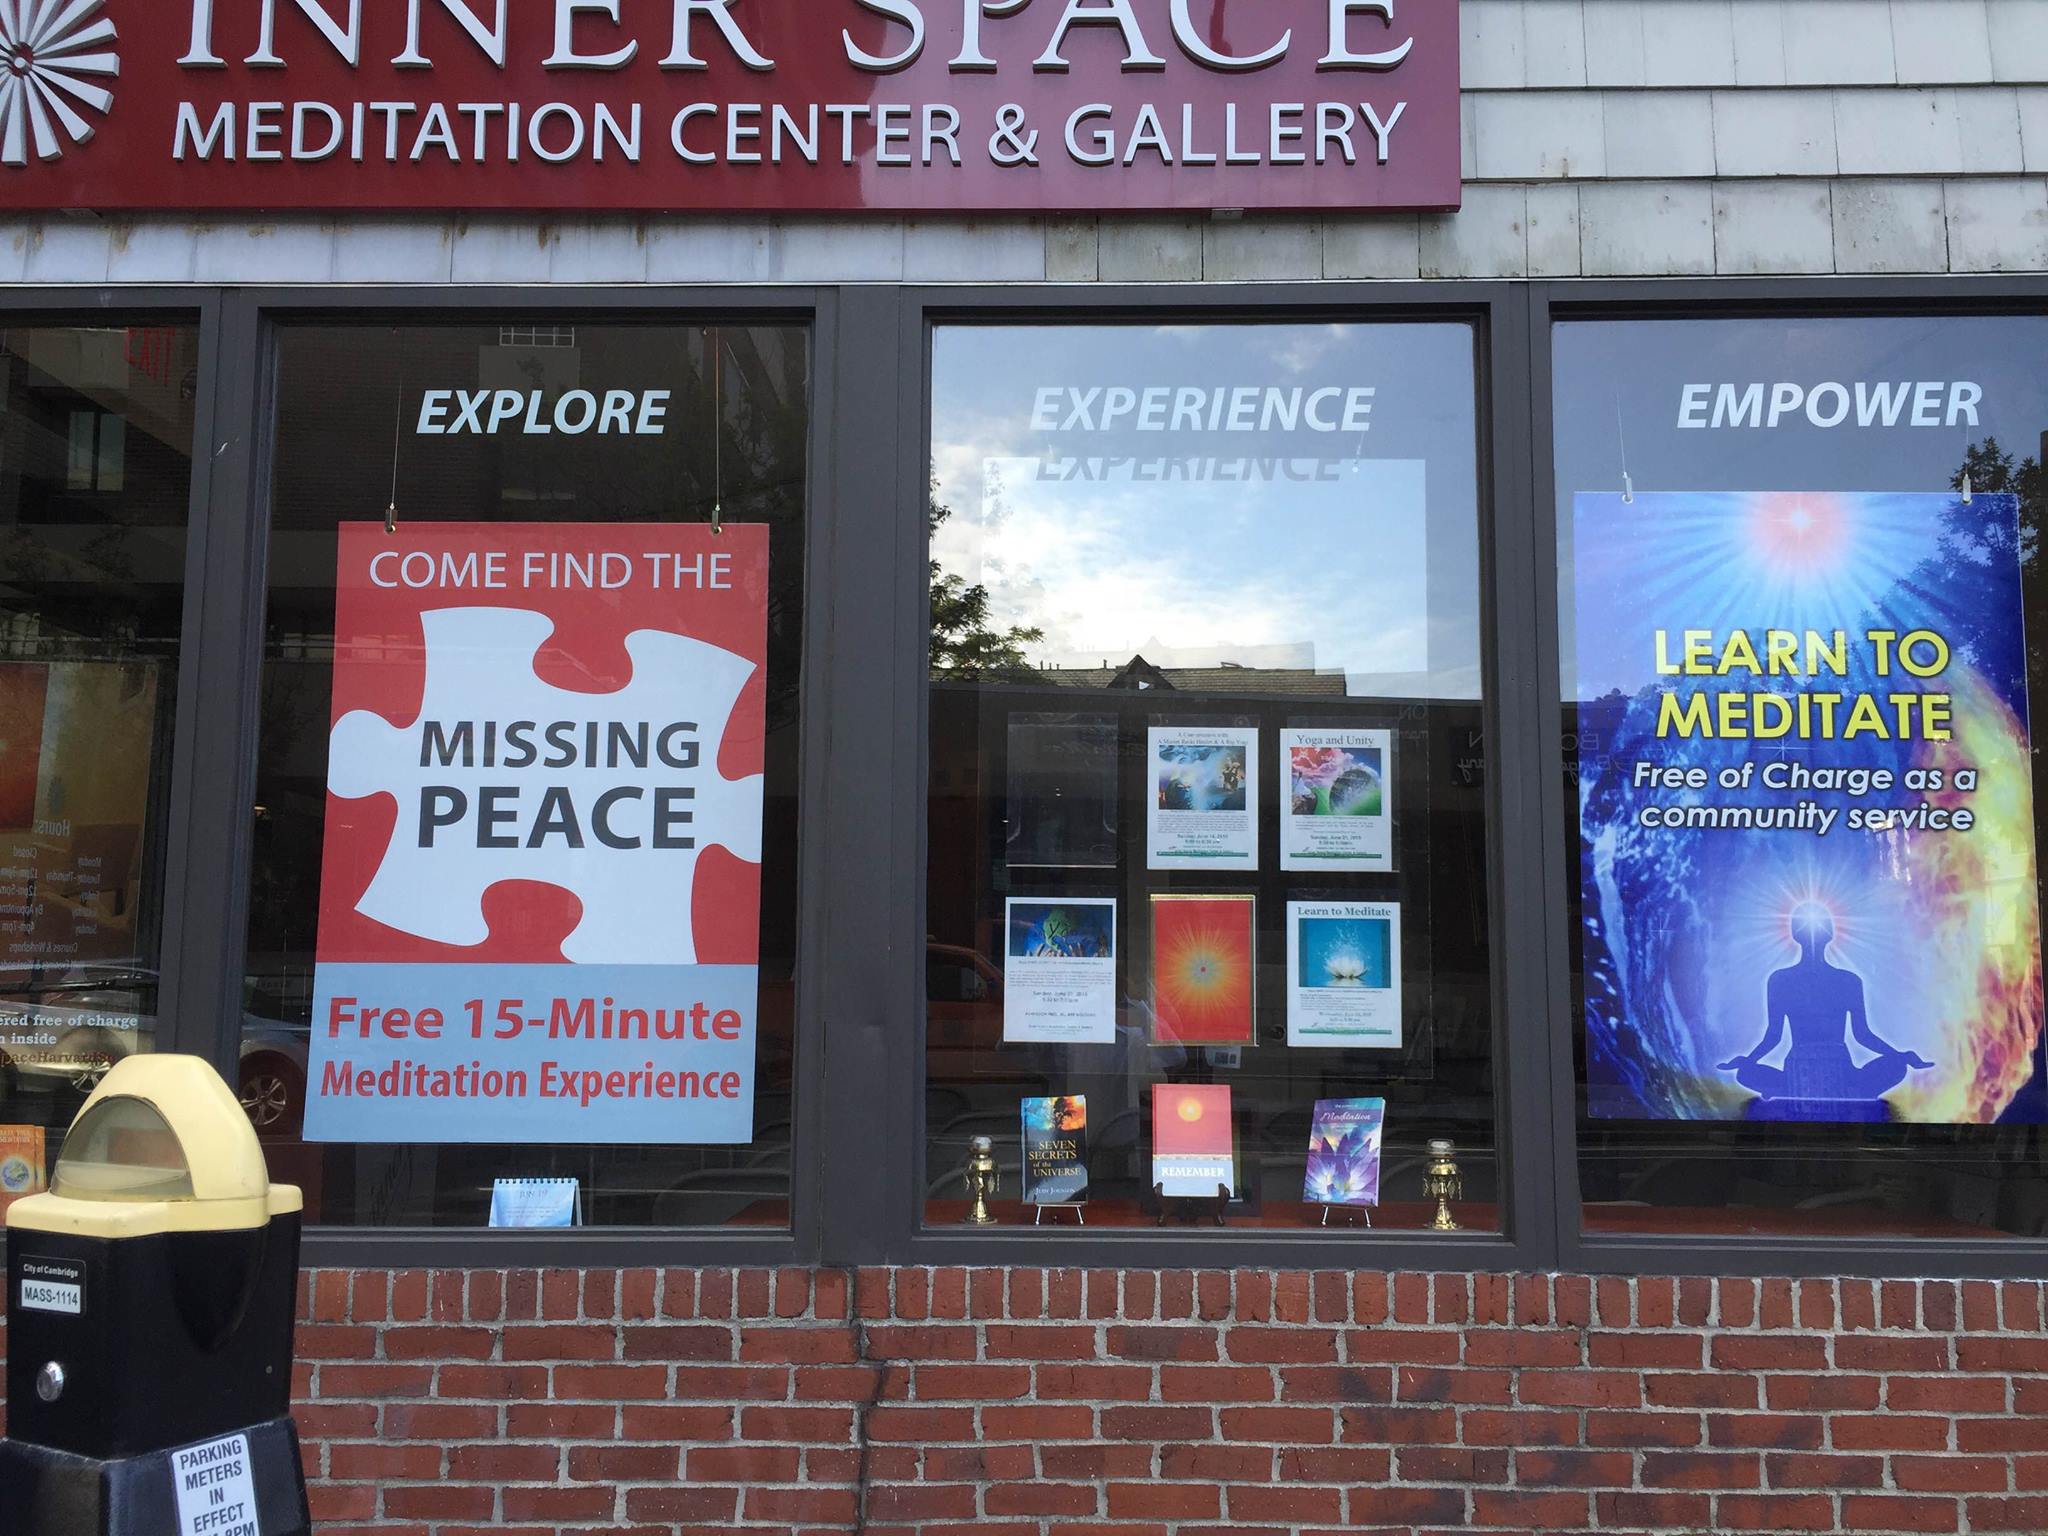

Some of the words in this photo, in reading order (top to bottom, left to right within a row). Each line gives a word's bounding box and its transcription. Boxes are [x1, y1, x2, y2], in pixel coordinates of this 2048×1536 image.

[173, 101, 642, 163] MEDITATION
[670, 103, 961, 166] CENTER
[987, 103, 1039, 167] &
[1064, 102, 1406, 167] GALLERY
[416, 389, 671, 435] EXPLORE
[1029, 386, 1375, 432] EXPERIENCE
[1676, 381, 1982, 428] EMPOWER
[369, 551, 507, 588] COME
[523, 552, 633, 588] FIND
[644, 553, 732, 589] THE
[1655, 630, 1846, 675] LEARN
[1868, 630, 1949, 676] TO
[1656, 693, 1952, 740] MEDITATE
[419, 720, 700, 768] MISSING
[1296, 735, 1323, 747] Yoga
[1326, 735, 1343, 745] and
[1346, 736, 1375, 748] Unity
[1633, 762, 1708, 789] Free
[1718, 763, 1753, 789] of
[1762, 763, 1893, 795] Charge
[1904, 767, 1949, 790] as
[1954, 768, 1976, 790] a
[418, 786, 696, 849] PEACE
[1640, 802, 1838, 835] community
[1848, 805, 1974, 830] service
[1297, 906, 1328, 916] Learn
[1331, 907, 1342, 916] to
[1345, 906, 1391, 916] Meditate
[33, 1014, 62, 1026] free
[68, 1014, 84, 1026] of
[87, 1014, 138, 1029] charge
[328, 997, 443, 1039] Free
[463, 998, 742, 1040] 15-Minute
[11, 1032, 57, 1044] inside
[321, 1060, 527, 1098] Meditation
[540, 1061, 740, 1107] Experience
[1029, 1150, 1077, 1160] SECRETS
[1039, 1140, 1076, 1149] SEVEN
[1033, 1168, 1081, 1176] UNIVERSE
[1161, 1167, 1225, 1177] REMEMBER
[24, 1264, 36, 1274] City
[44, 1266, 78, 1278] Cambridge
[25, 1287, 78, 1305] MASS-1114
[180, 1439, 242, 1470] PARKING
[185, 1461, 242, 1491] METERS
[209, 1487, 224, 1506] IN
[193, 1502, 244, 1533] EFFECT
